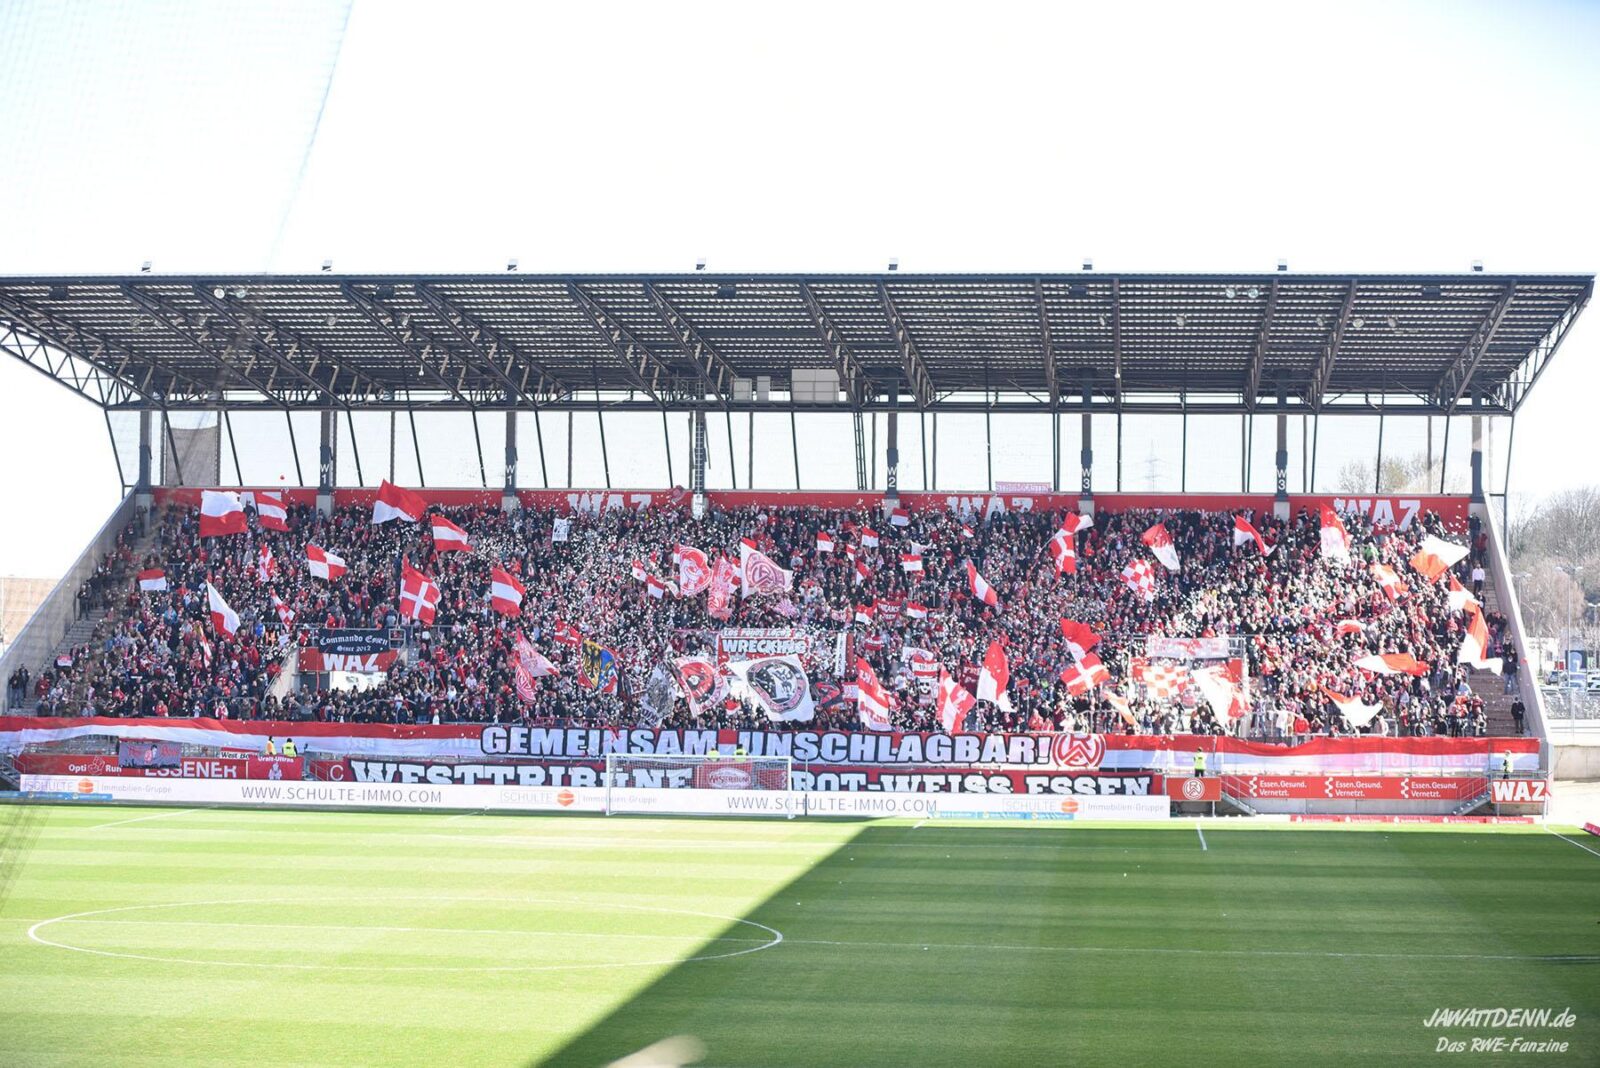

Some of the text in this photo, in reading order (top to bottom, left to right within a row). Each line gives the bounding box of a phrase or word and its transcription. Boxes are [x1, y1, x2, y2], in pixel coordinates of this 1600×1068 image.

[1333, 499, 1421, 531] WAZ
[319, 634, 363, 646] Commando
[322, 652, 379, 671] WAZ
[481, 725, 1051, 766] GEMEINSAM UNSCHLAGBAR!
[68, 763, 121, 773] Opti Run
[350, 760, 693, 787] WESTTRIBÜNE
[790, 770, 1013, 796] ROT-WEISS
[1025, 775, 1150, 796] ESSEN
[1259, 780, 1306, 789] Essen.Gesund.
[1335, 781, 1382, 790] Essen.Gesund.
[1411, 781, 1458, 790] Essen.Gesund.
[240, 785, 442, 804] WWW.SCHULTE-IMMO.COM
[1259, 789, 1289, 797] Vernetzt.
[1335, 789, 1365, 798] Vernetzt.
[1411, 790, 1441, 798] Vernetzt.
[1493, 781, 1545, 802] WAZ
[503, 792, 552, 803] SCHULTE
[727, 796, 937, 813] WWW.SCHULTE-IMMO.COM
